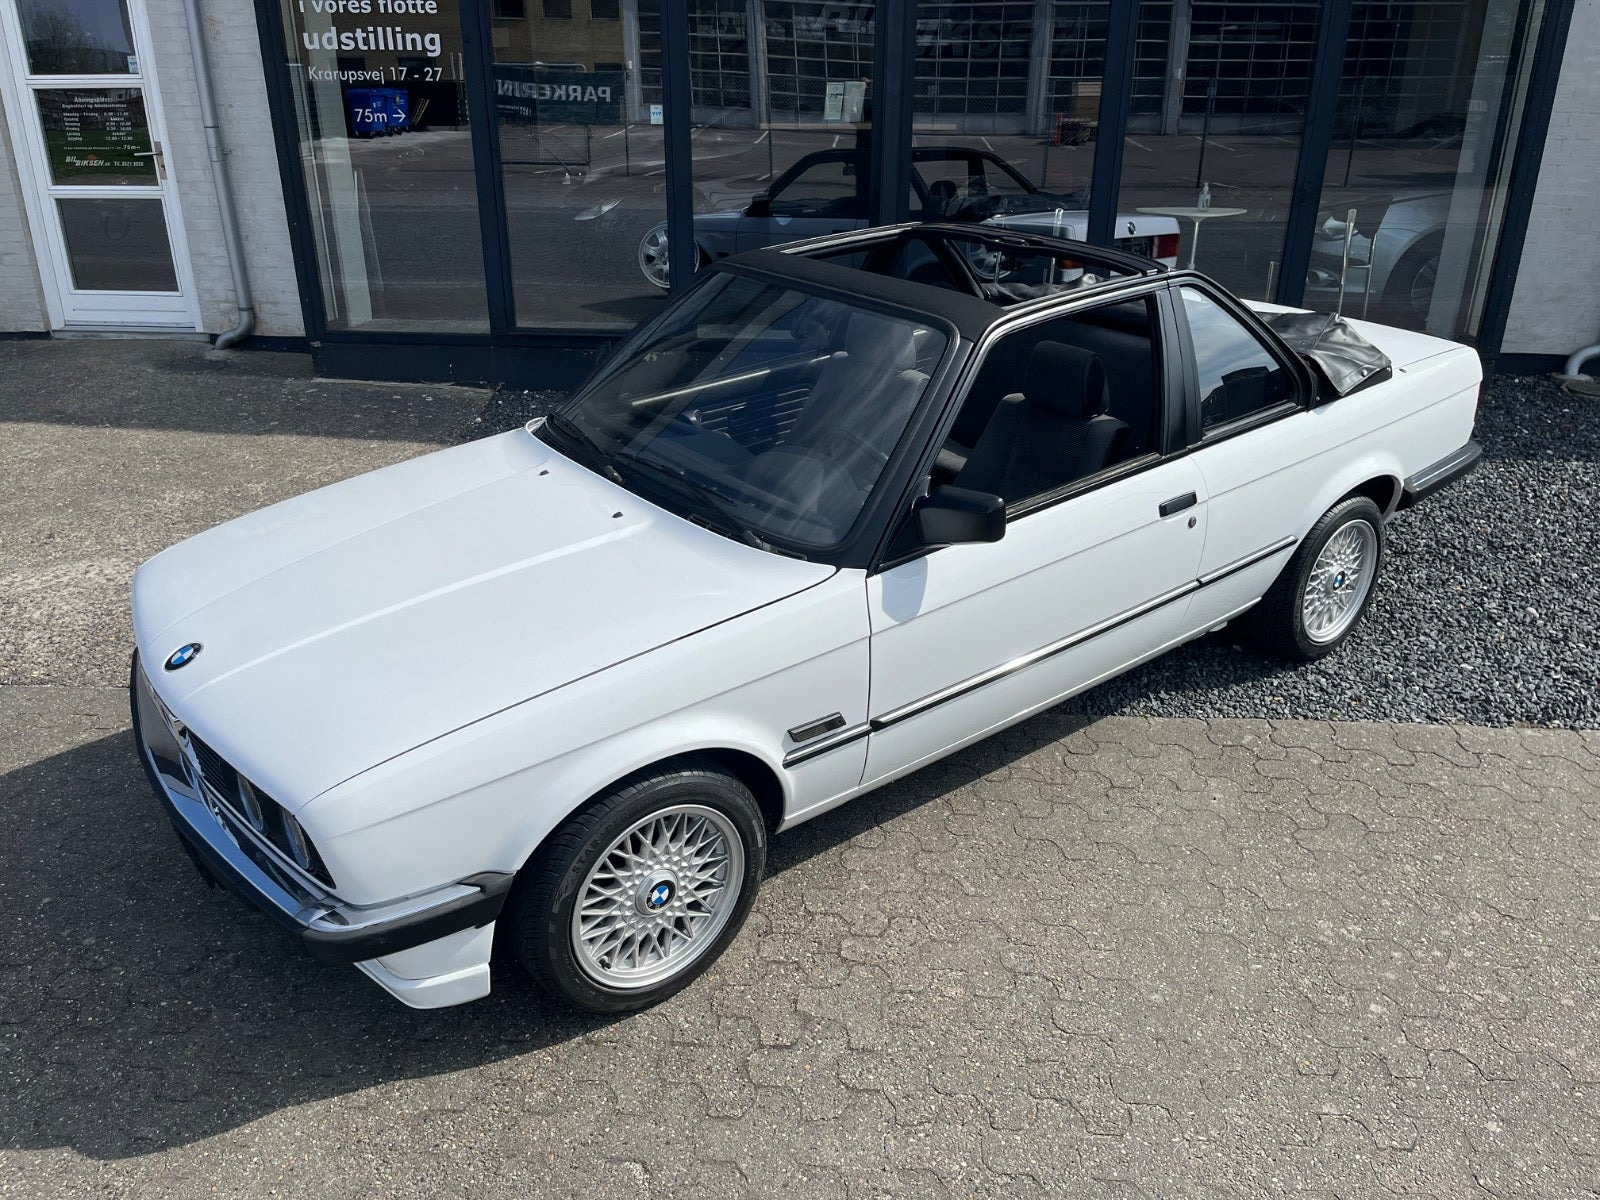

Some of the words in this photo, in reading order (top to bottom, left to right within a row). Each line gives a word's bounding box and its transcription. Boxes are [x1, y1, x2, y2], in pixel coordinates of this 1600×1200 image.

[311, 1, 372, 14] vores
[378, 0, 438, 14] flotte
[303, 27, 442, 57] udstilling
[308, 66, 385, 84] Krarupsvej
[390, 67, 407, 81] 17
[424, 67, 443, 82] 27
[354, 108, 387, 122] 75m
